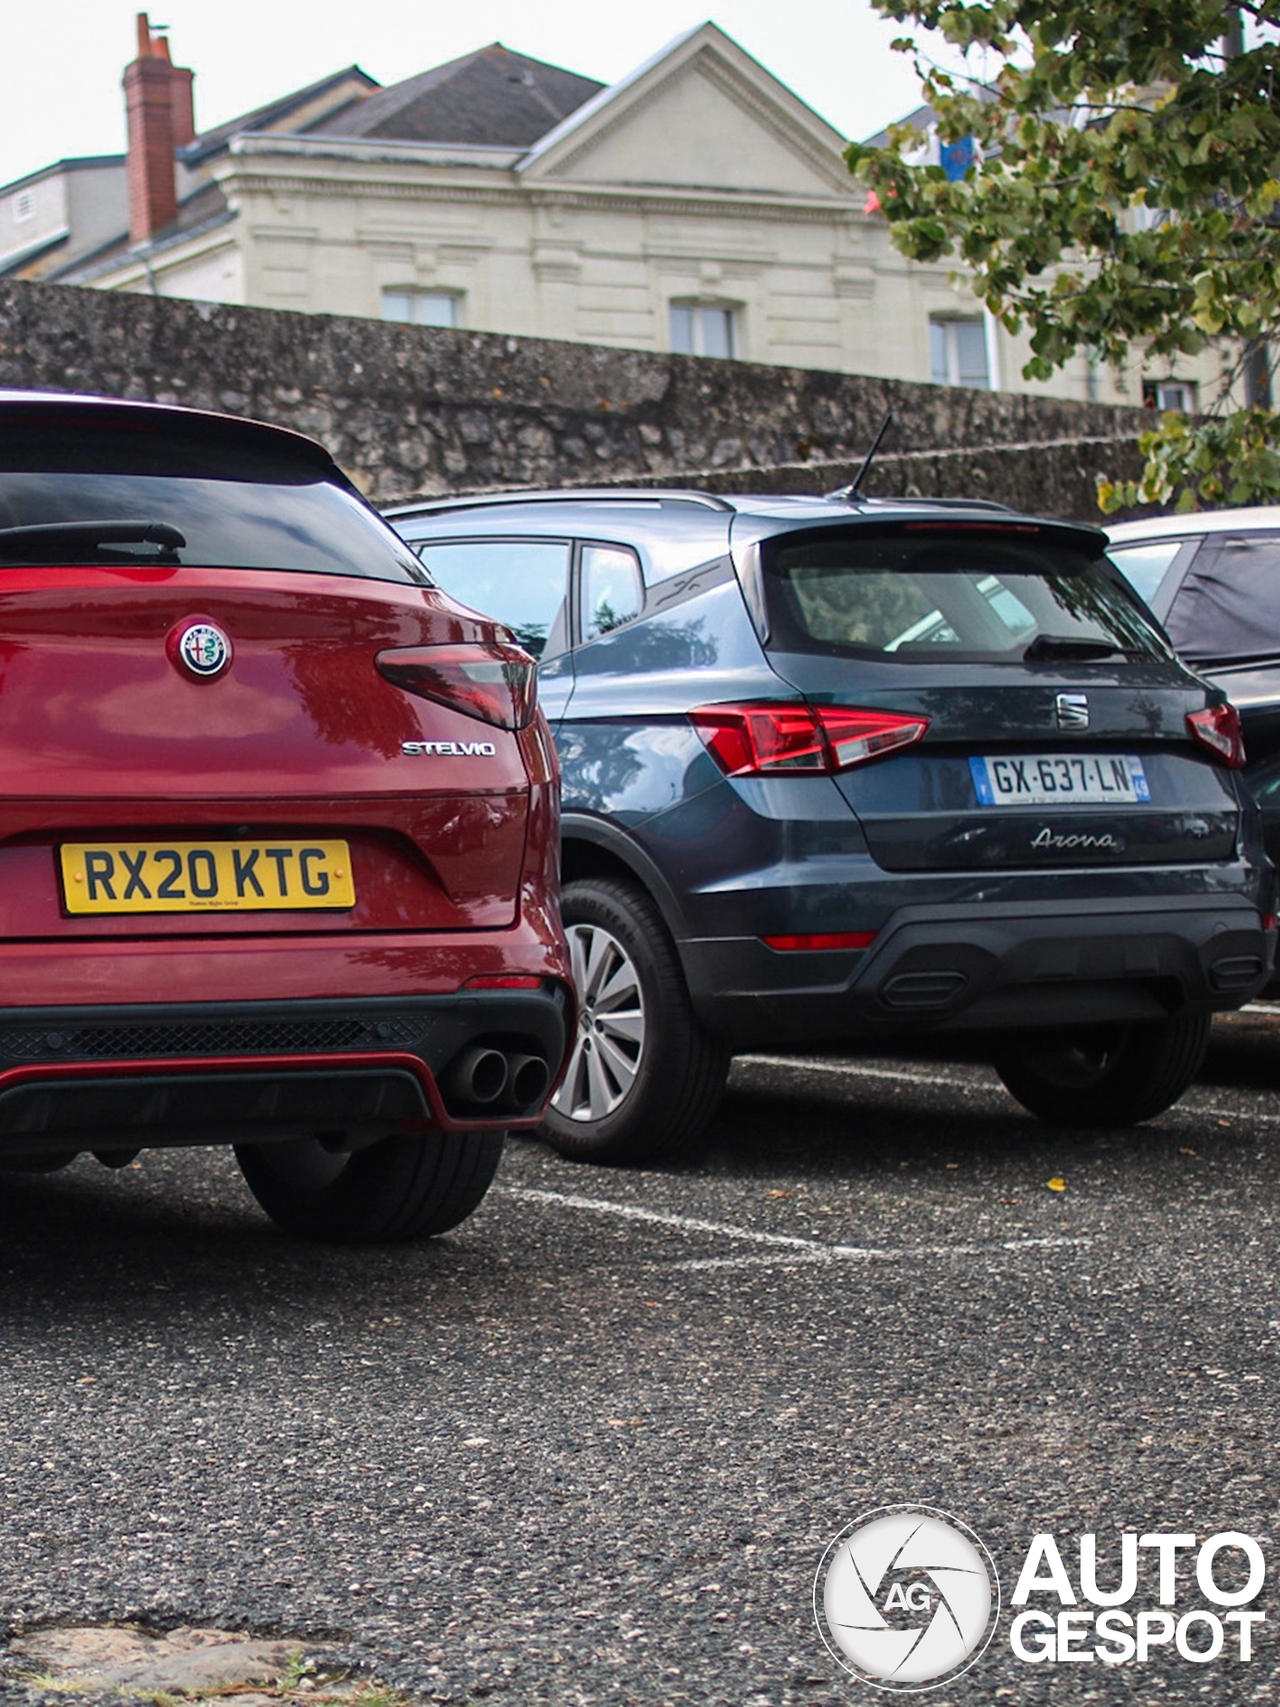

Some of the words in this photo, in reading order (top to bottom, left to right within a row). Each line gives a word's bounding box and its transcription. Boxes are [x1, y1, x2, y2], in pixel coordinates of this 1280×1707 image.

[402, 741, 496, 756] STELVIO
[1031, 828, 1117, 848] Arona
[84, 850, 218, 900] RX20
[232, 848, 330, 898] KTG
